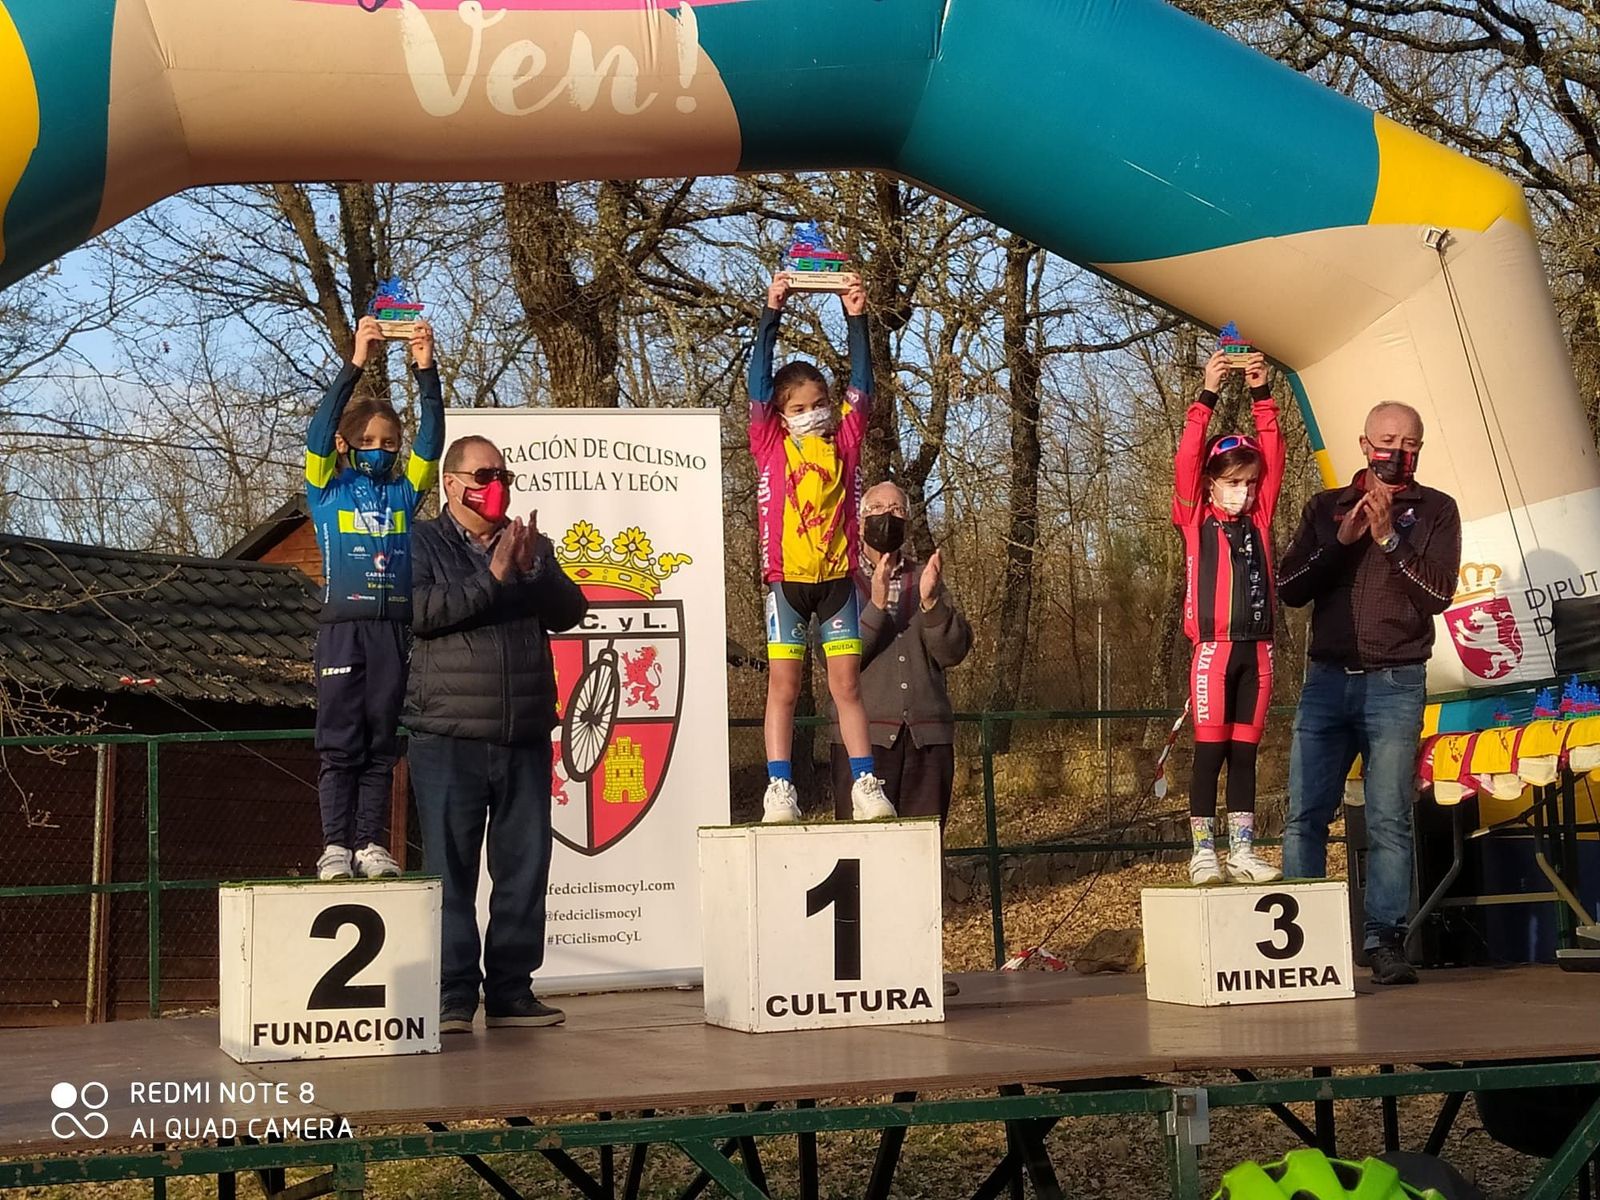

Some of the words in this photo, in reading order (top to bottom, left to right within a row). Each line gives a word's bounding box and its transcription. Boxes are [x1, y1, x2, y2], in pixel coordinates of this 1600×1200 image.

[397, 0, 699, 116] Ven!
[582, 437, 609, 459] DE
[612, 441, 707, 471] CICLISMO
[514, 471, 606, 492] CASTILLA
[613, 471, 624, 491] Y
[628, 470, 679, 492] LEÓN
[1524, 570, 1598, 610] DIPUT
[618, 616, 634, 632] y
[643, 612, 667, 629] L.
[1196, 641, 1218, 671] CAJA
[1196, 673, 1211, 724] RURAL
[806, 858, 861, 981] 1
[1253, 892, 1305, 960] 3
[547, 930, 642, 946] #FCiclismoCyL
[306, 903, 386, 1011] 2
[1216, 965, 1341, 992] MINERA
[765, 987, 933, 1018] CULTURA
[252, 1017, 425, 1046] FUNDACION
